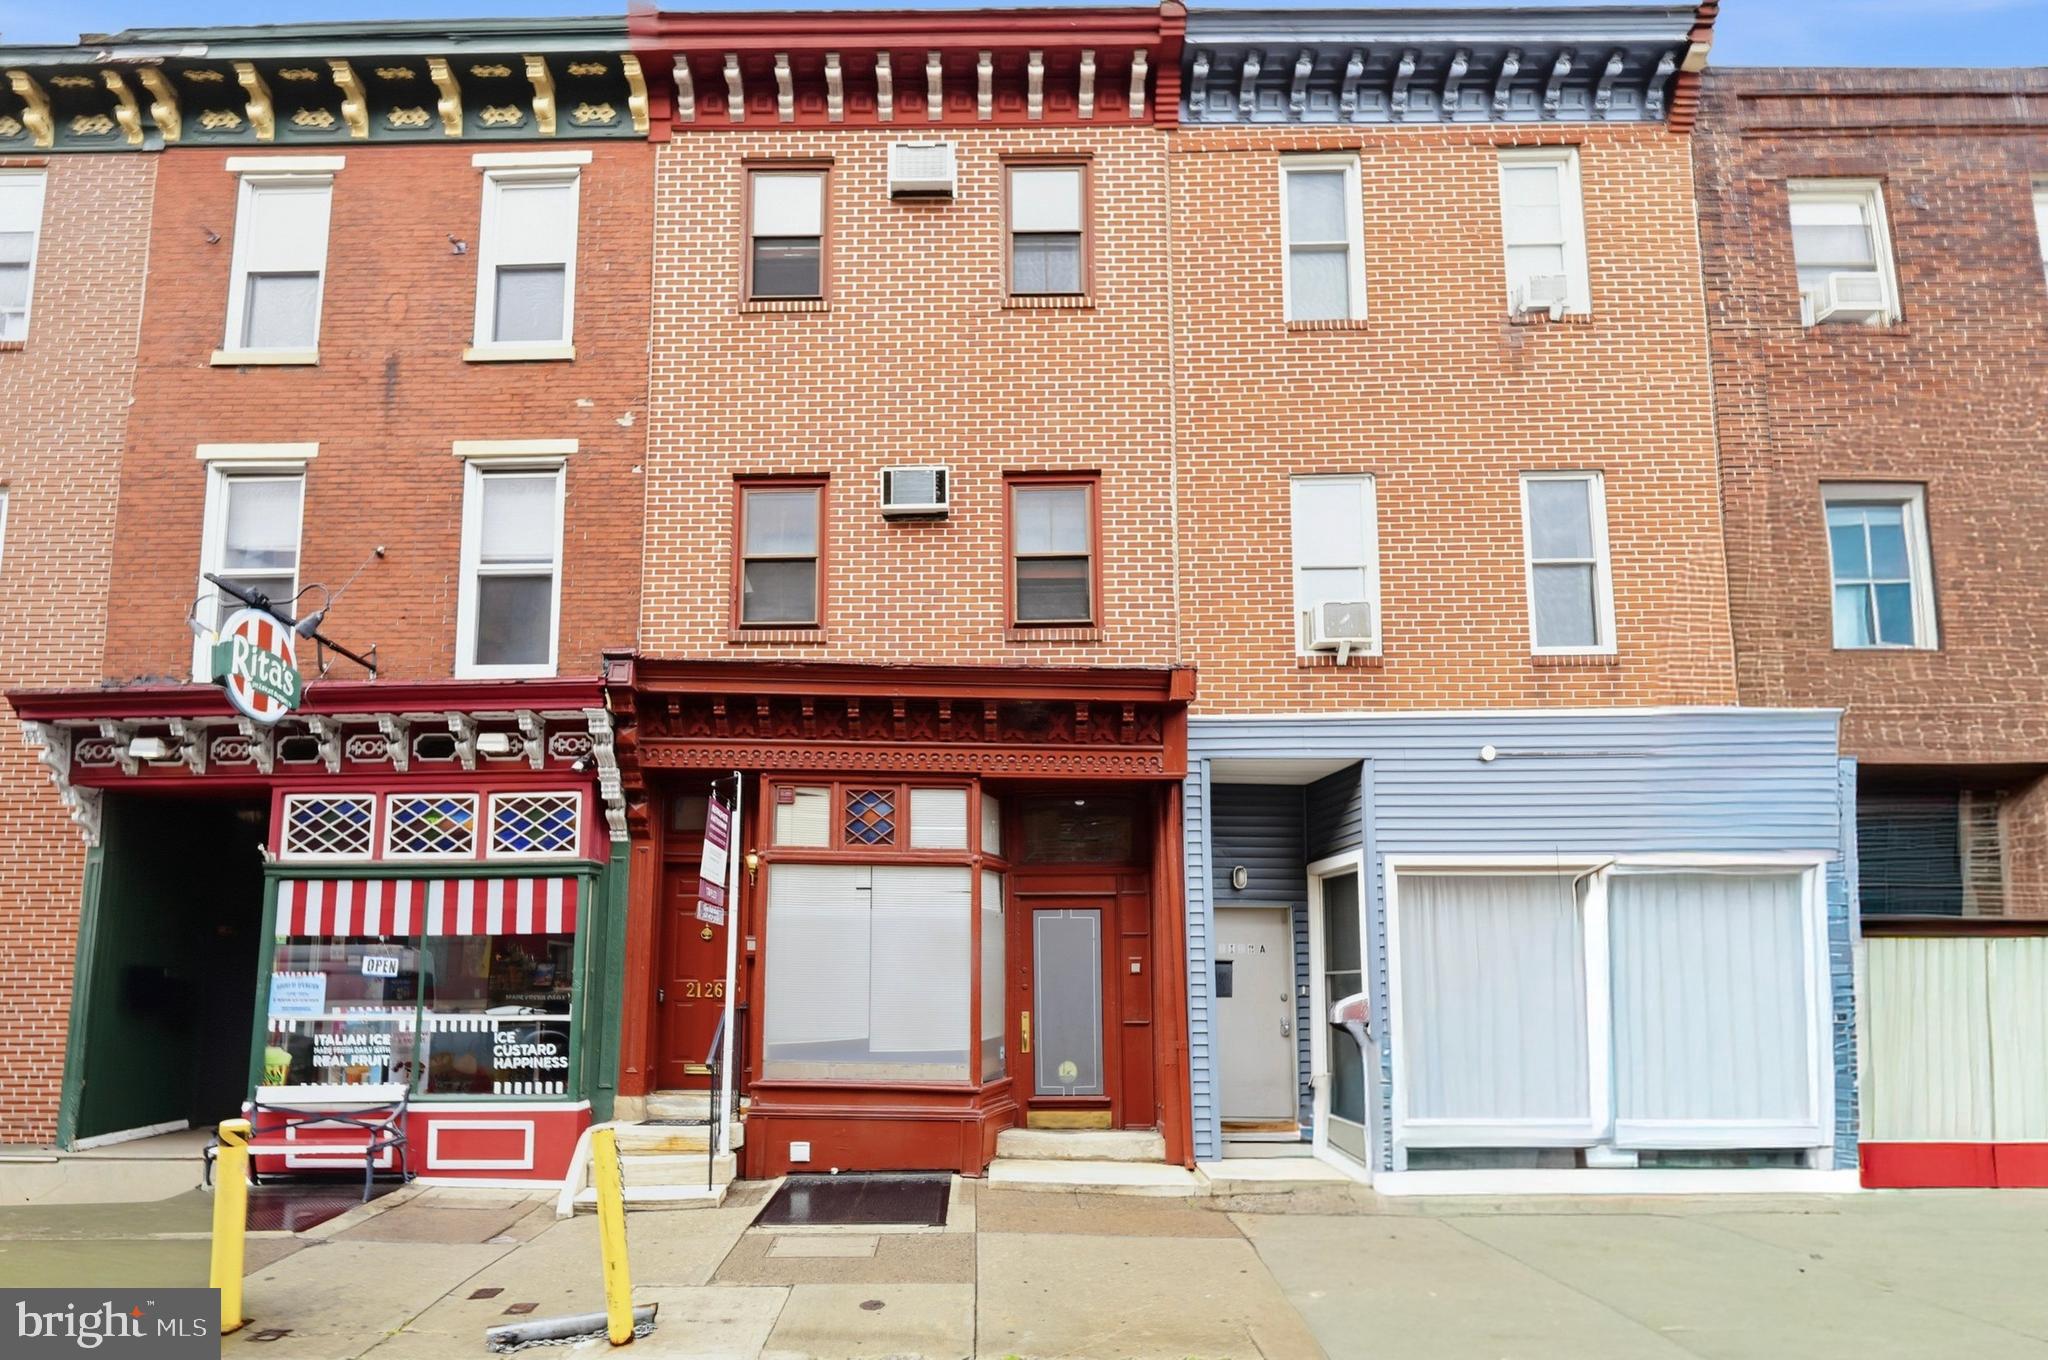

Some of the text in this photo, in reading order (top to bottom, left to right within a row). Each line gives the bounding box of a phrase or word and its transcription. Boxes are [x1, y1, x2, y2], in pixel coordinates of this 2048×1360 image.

[231, 634, 295, 696] Rita's
[366, 958, 397, 975] OPEN
[686, 982, 723, 998] 2126
[313, 1033, 367, 1046] ITALIAN
[369, 1033, 391, 1046] ICE
[494, 1031, 516, 1044] ICE
[493, 1043, 557, 1057] CUSTARD
[313, 1054, 390, 1067] REAL FRUIT
[493, 1056, 569, 1070] HAPPINESS
